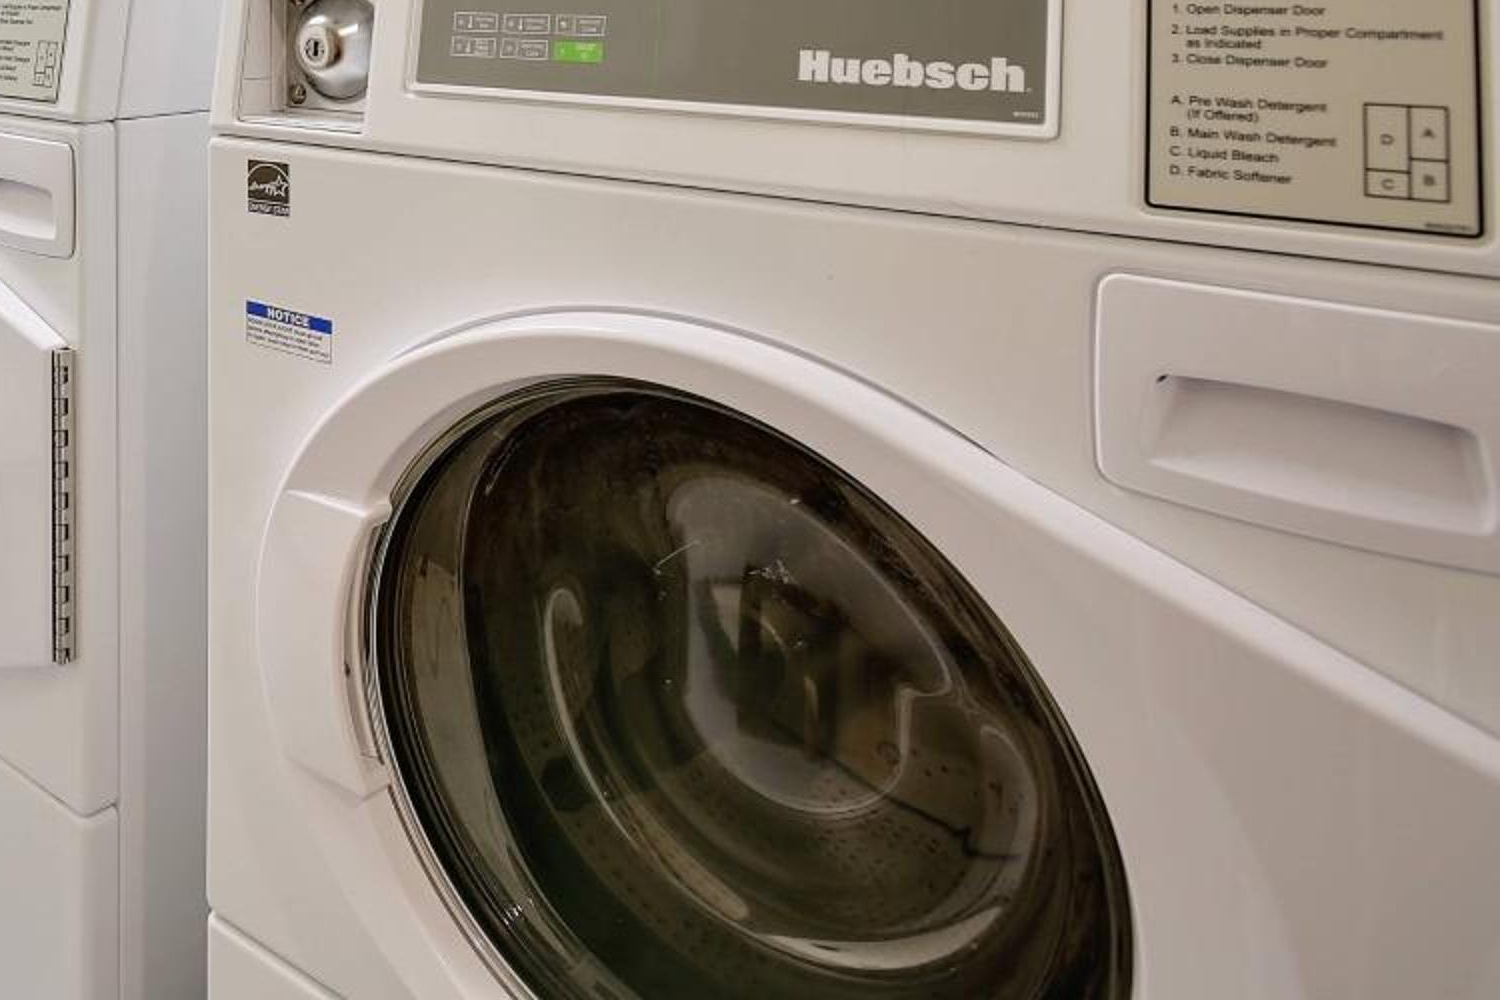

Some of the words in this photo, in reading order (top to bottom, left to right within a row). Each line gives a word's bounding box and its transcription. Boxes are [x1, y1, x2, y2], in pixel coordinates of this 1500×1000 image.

[1186, 3, 1220, 16] Open
[1223, 3, 1288, 17] Dispenser
[1292, 4, 1326, 16] Door
[1186, 25, 1217, 35] Load
[1220, 25, 1275, 38] Supplies
[1295, 26, 1340, 39] Proper
[1345, 27, 1444, 41] Compartment
[1186, 39, 1200, 49] as
[1204, 38, 1262, 49] Indicated
[1186, 53, 1221, 65] Close
[1225, 54, 1290, 68] Dispenser
[1294, 56, 1328, 69] Door
[798, 48, 1026, 93] Huebsch
[1189, 95, 1211, 107] Pre
[1215, 96, 1253, 109] Wash
[1257, 98, 1328, 115] Detergent
[1188, 127, 1219, 139] Main
[1223, 130, 1261, 142] Wash
[1266, 132, 1337, 148] Detergent
[1380, 133, 1395, 146] D
[1422, 127, 1436, 139] A
[1187, 147, 1228, 161] Liquid
[1231, 149, 1280, 163] Bleach
[1187, 165, 1229, 180] Fabric
[1233, 169, 1293, 185] Softener
[1381, 178, 1395, 191] C
[267, 306, 309, 328] NOTICE
